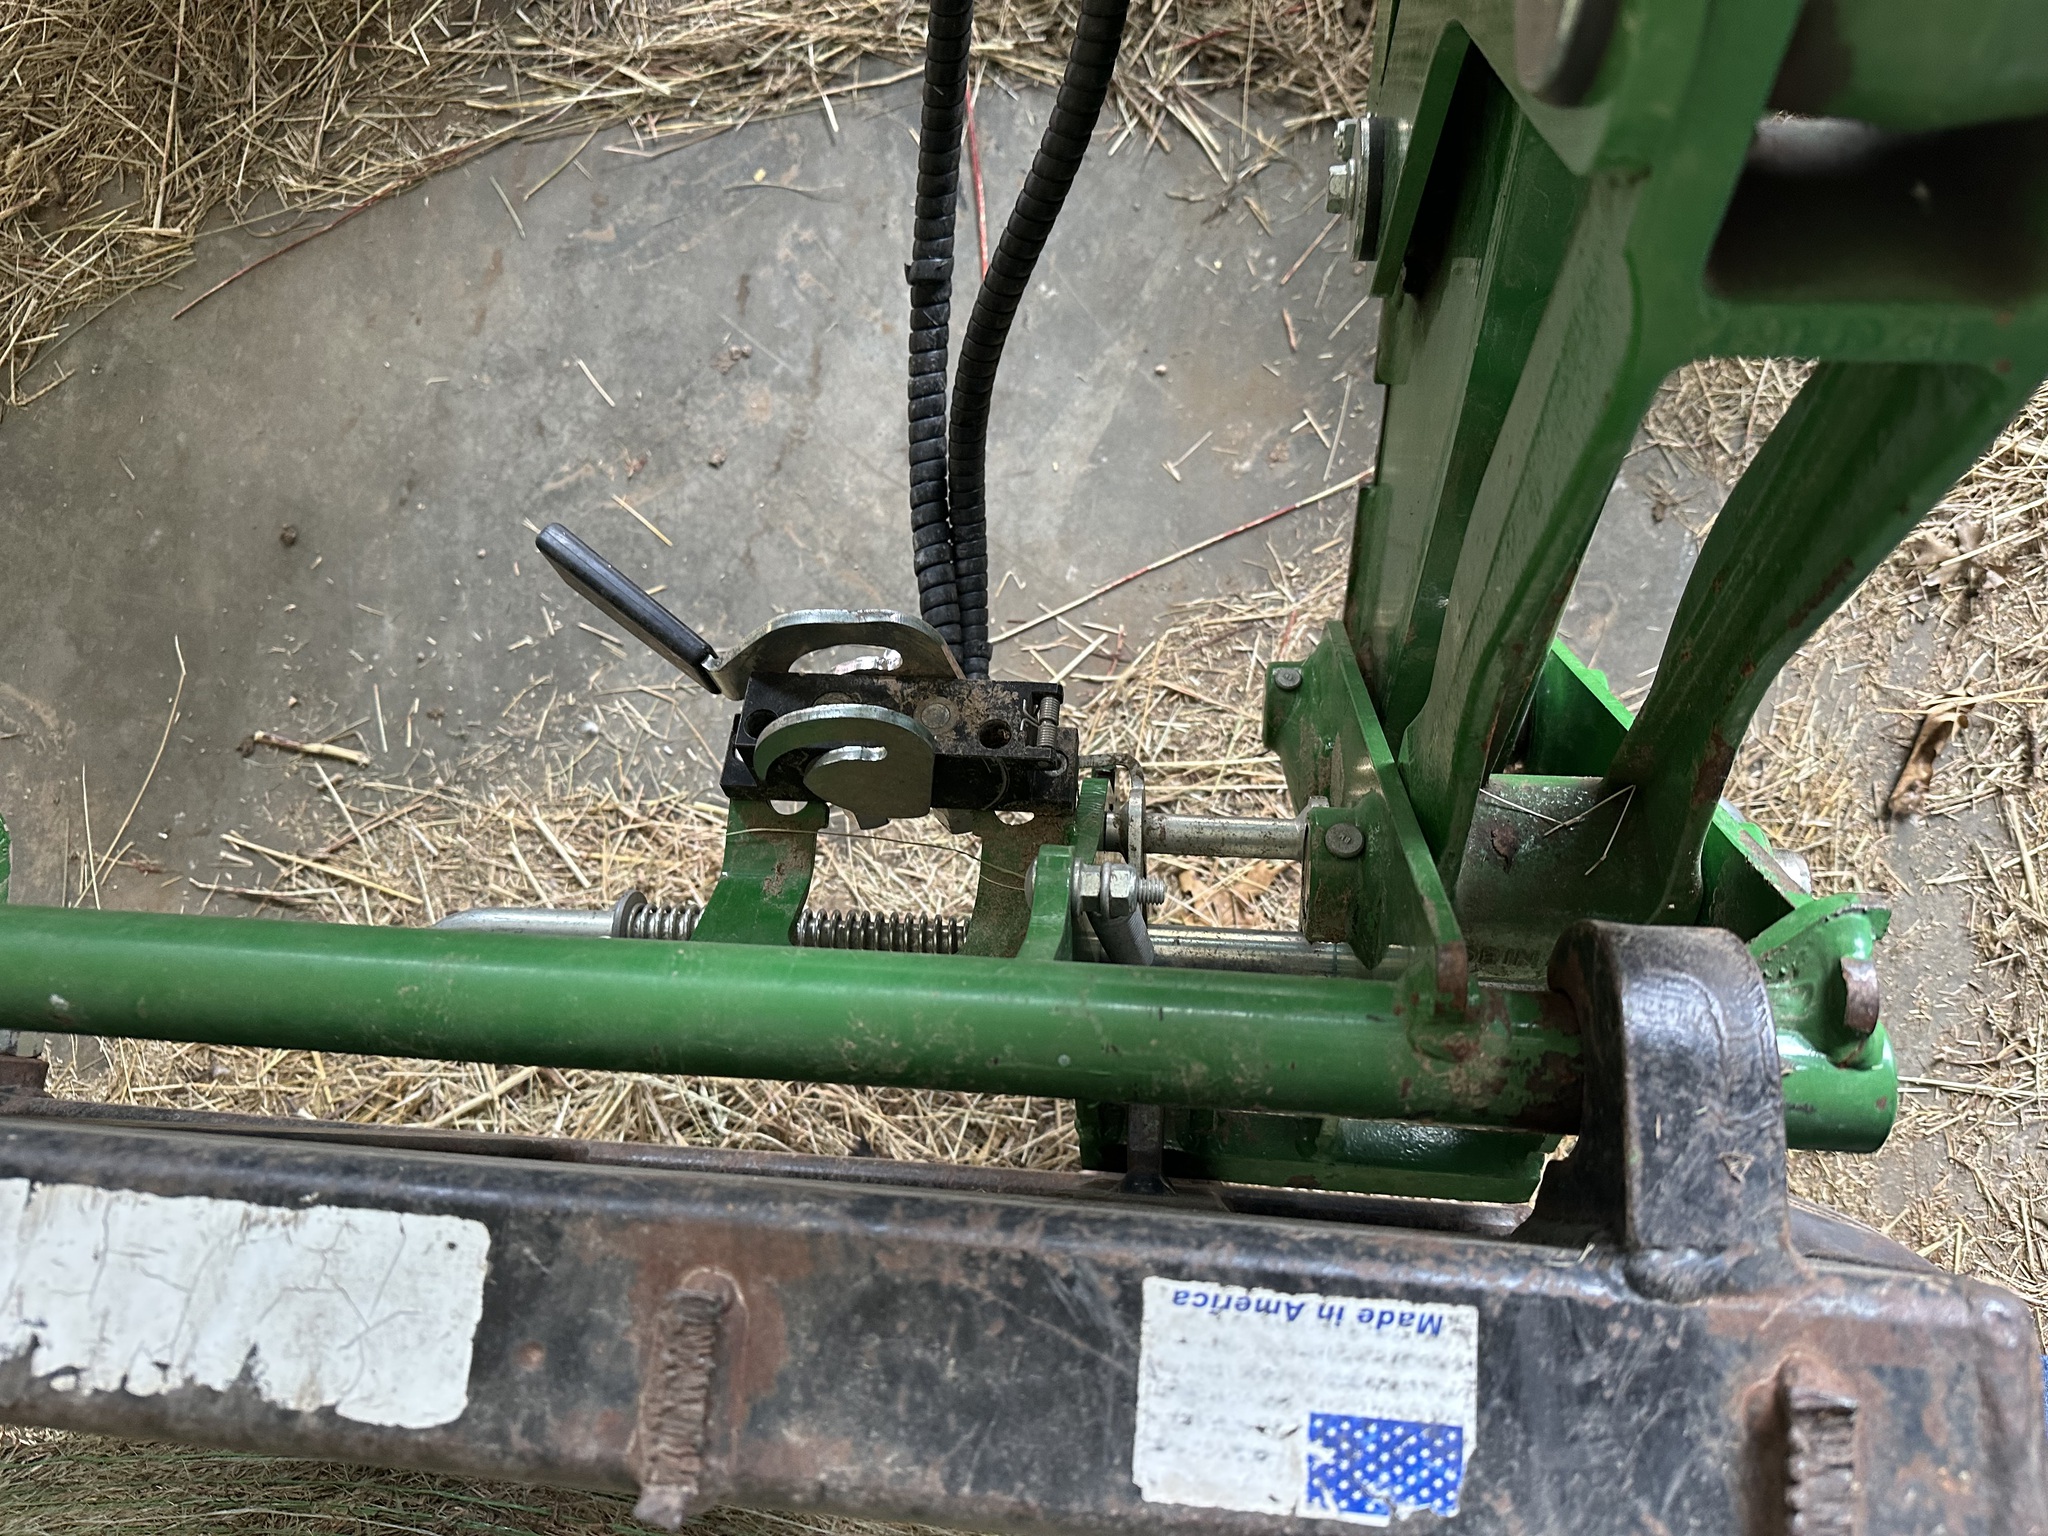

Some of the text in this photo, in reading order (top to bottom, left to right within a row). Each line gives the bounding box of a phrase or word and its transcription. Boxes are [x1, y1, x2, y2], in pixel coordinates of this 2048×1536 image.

[1172, 1289, 1443, 1336] Made in America
